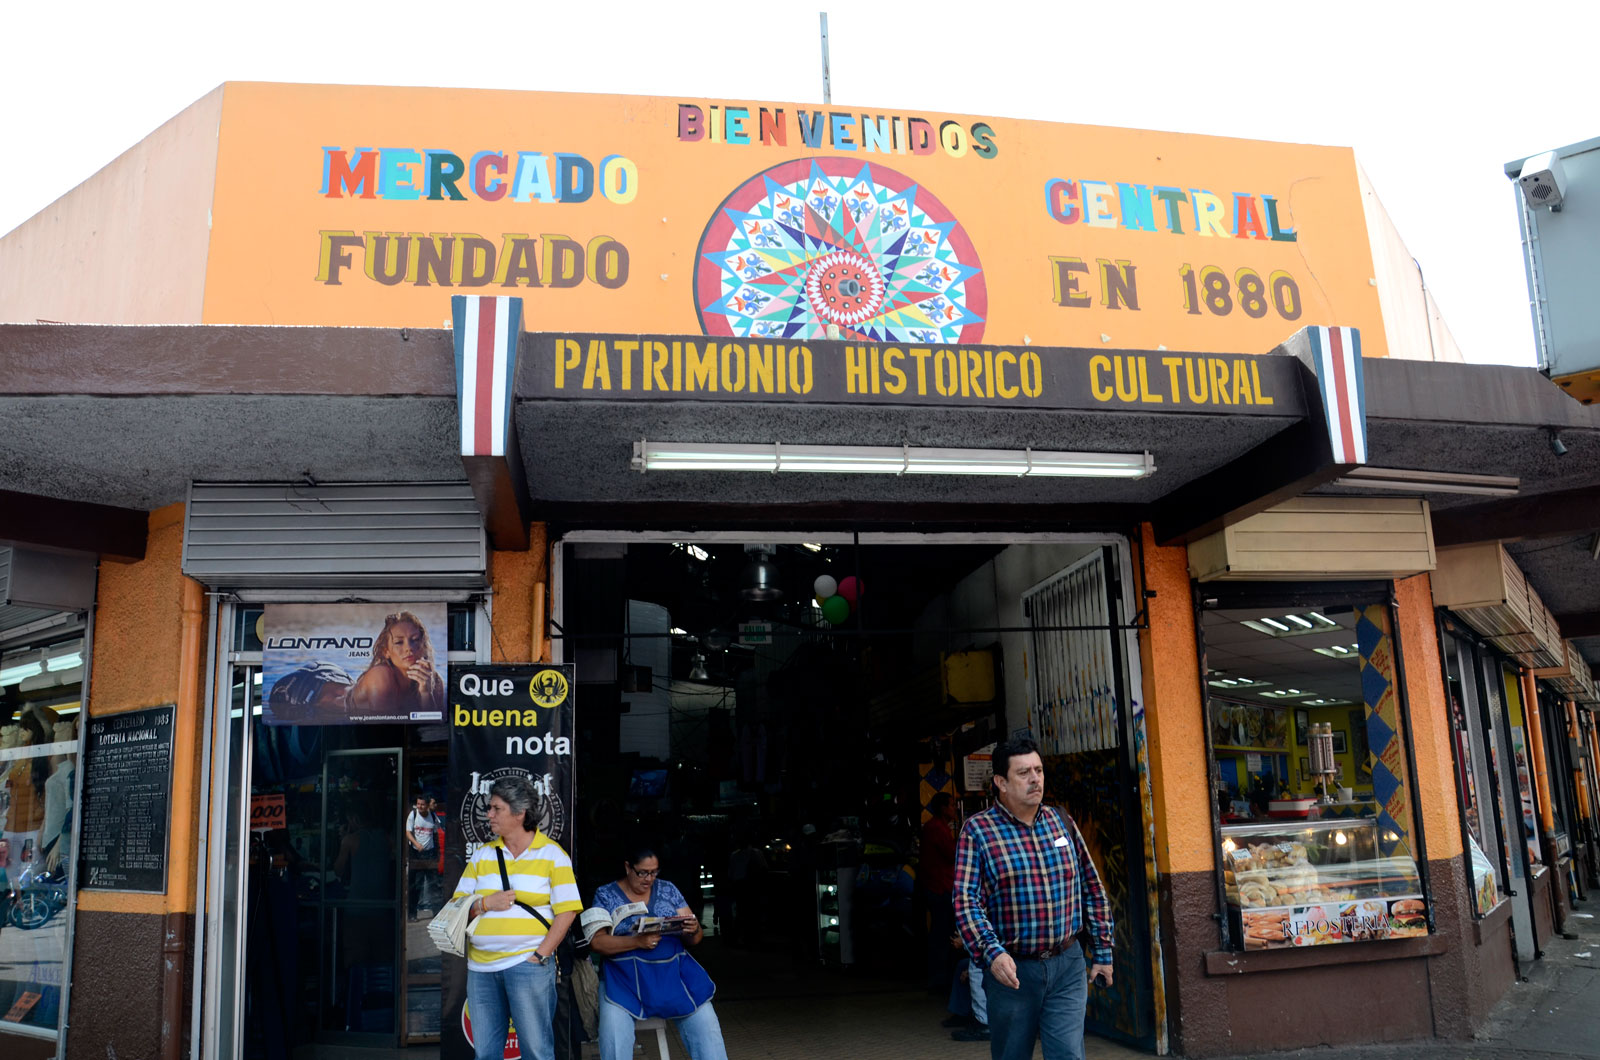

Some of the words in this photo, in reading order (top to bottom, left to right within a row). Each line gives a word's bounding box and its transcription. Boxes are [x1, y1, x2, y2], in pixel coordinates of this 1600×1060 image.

[677, 103, 998, 159] BIENVENIDOS
[319, 146, 638, 205] MERCADO
[1044, 177, 1297, 243] CENTRAL
[315, 230, 630, 289] FUNDADO
[1048, 255, 1141, 311] EN
[1178, 262, 1303, 321] 1880
[554, 338, 814, 396] PATRIMONIO
[845, 346, 1043, 399] HISTORICO
[1089, 355, 1274, 406] CULTURAL
[267, 637, 374, 650] LONTANO
[459, 673, 515, 697] Que
[454, 704, 538, 727] buena
[99, 732, 126, 746] LOTERIA
[127, 728, 158, 742] NACIONAL
[505, 731, 571, 755] nota
[1282, 913, 1392, 938] REPOSTERIA
